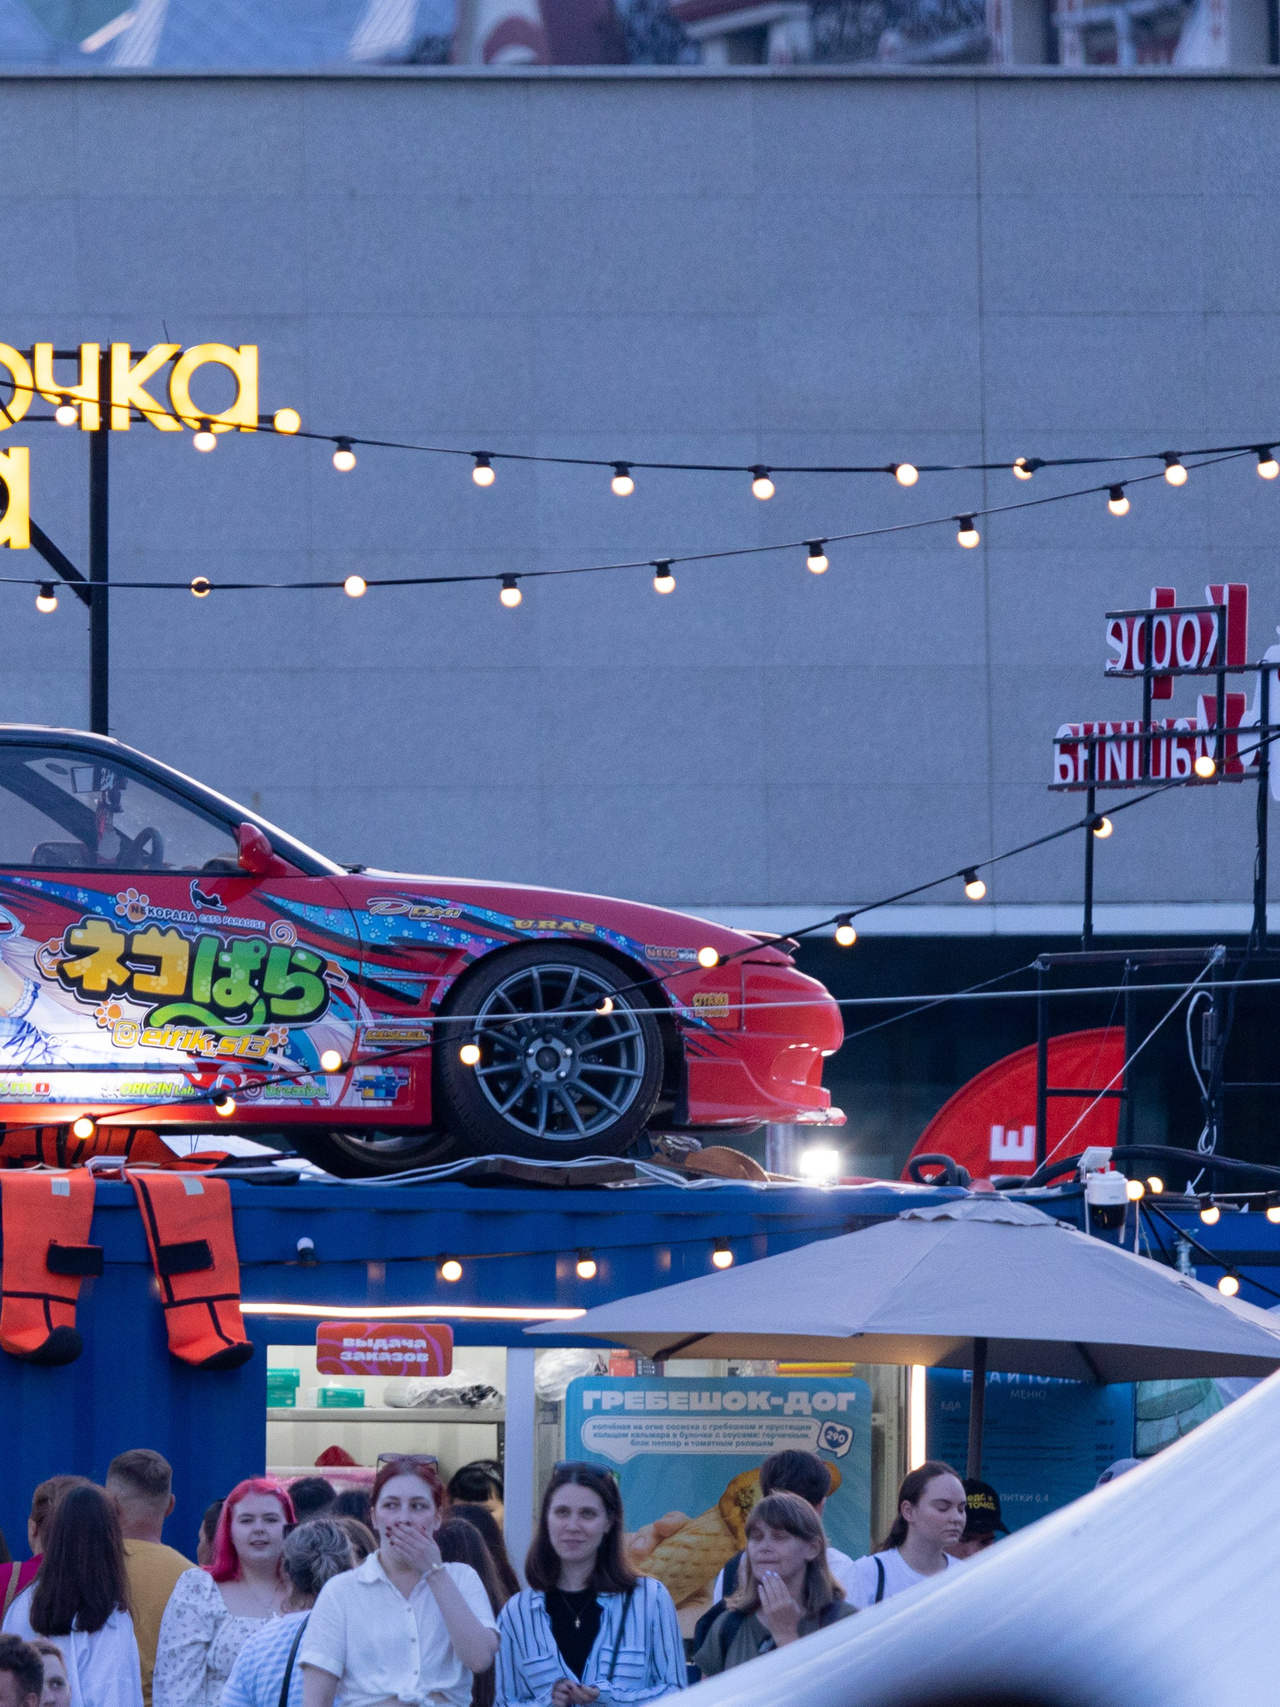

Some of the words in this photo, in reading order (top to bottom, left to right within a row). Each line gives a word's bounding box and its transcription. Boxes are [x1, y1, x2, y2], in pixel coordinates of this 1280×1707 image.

[131, 905, 197, 922] NEKOPARA
[120, 1081, 174, 1097] ORIGIN
[342, 1337, 427, 1350] выдача
[339, 1351, 429, 1363] заказов
[583, 1391, 856, 1415] ГРЕБЕШОК-ДОГ
